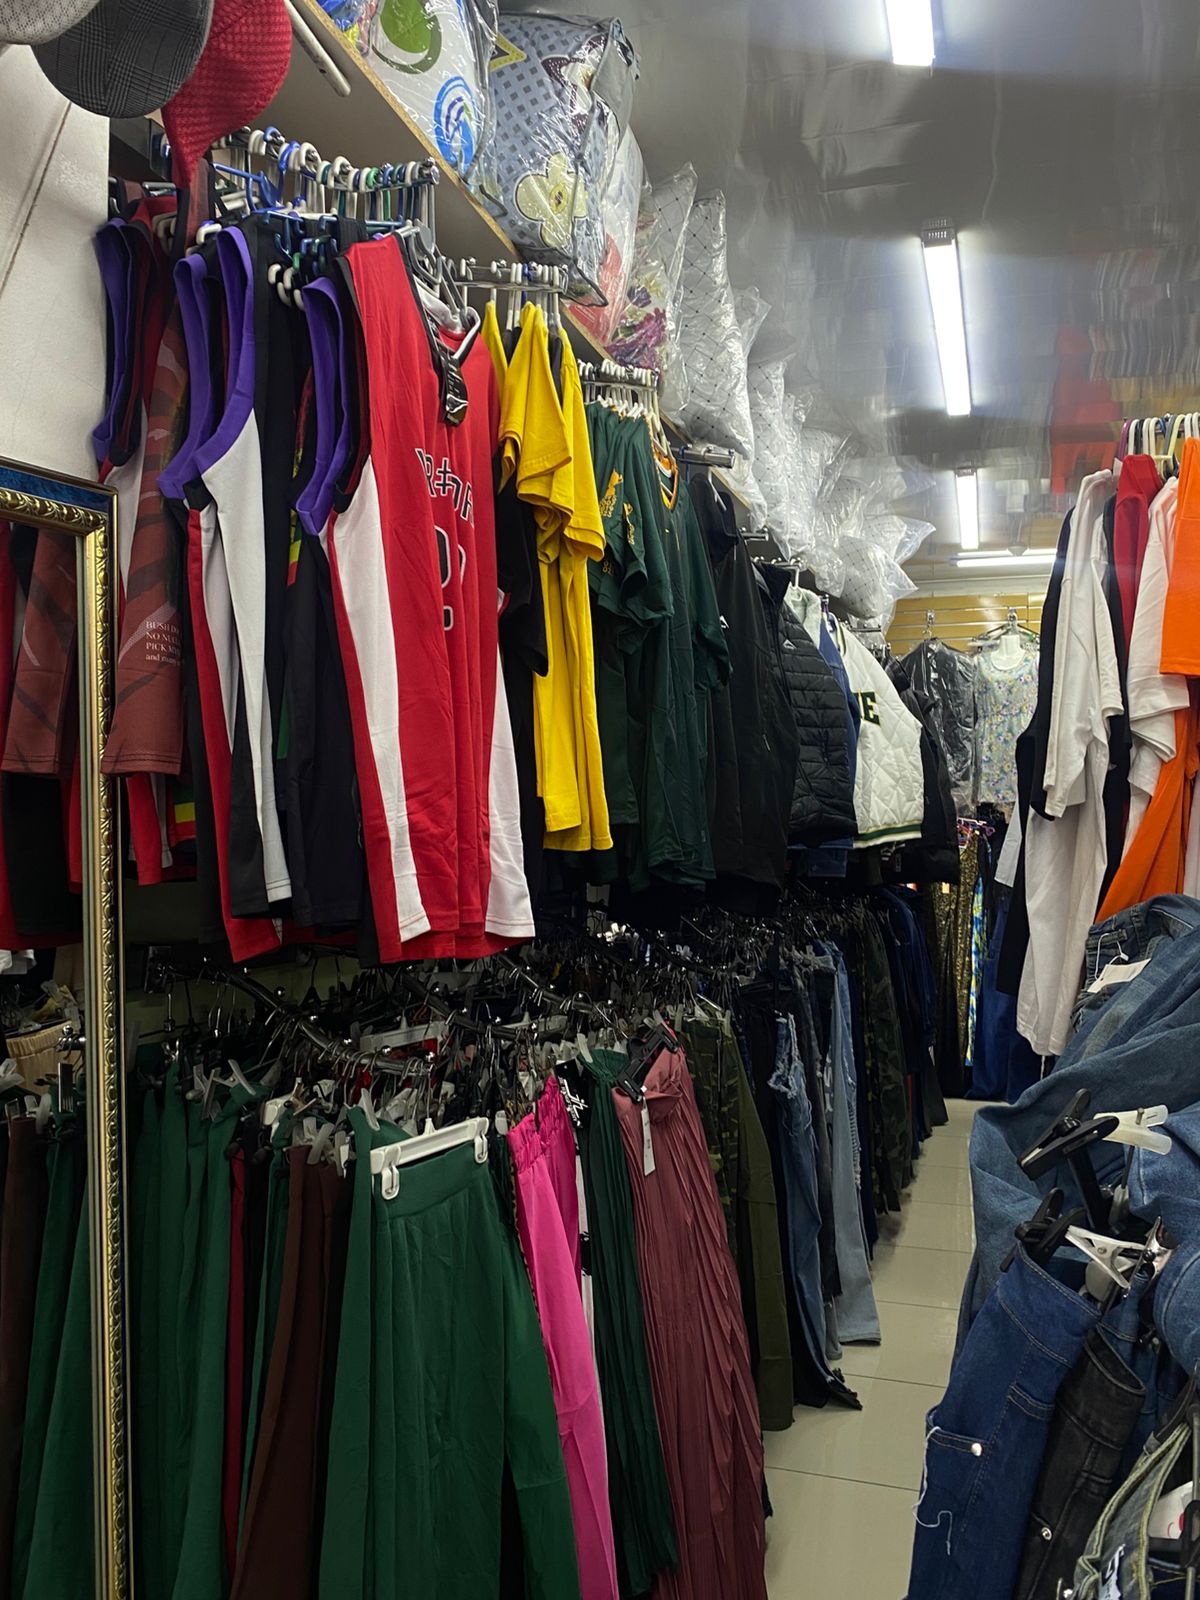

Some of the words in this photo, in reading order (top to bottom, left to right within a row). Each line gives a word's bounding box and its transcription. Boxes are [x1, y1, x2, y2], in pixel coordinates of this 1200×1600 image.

[145, 631, 160, 640] NO
[145, 642, 167, 653] PICK
[145, 653, 160, 661] and
